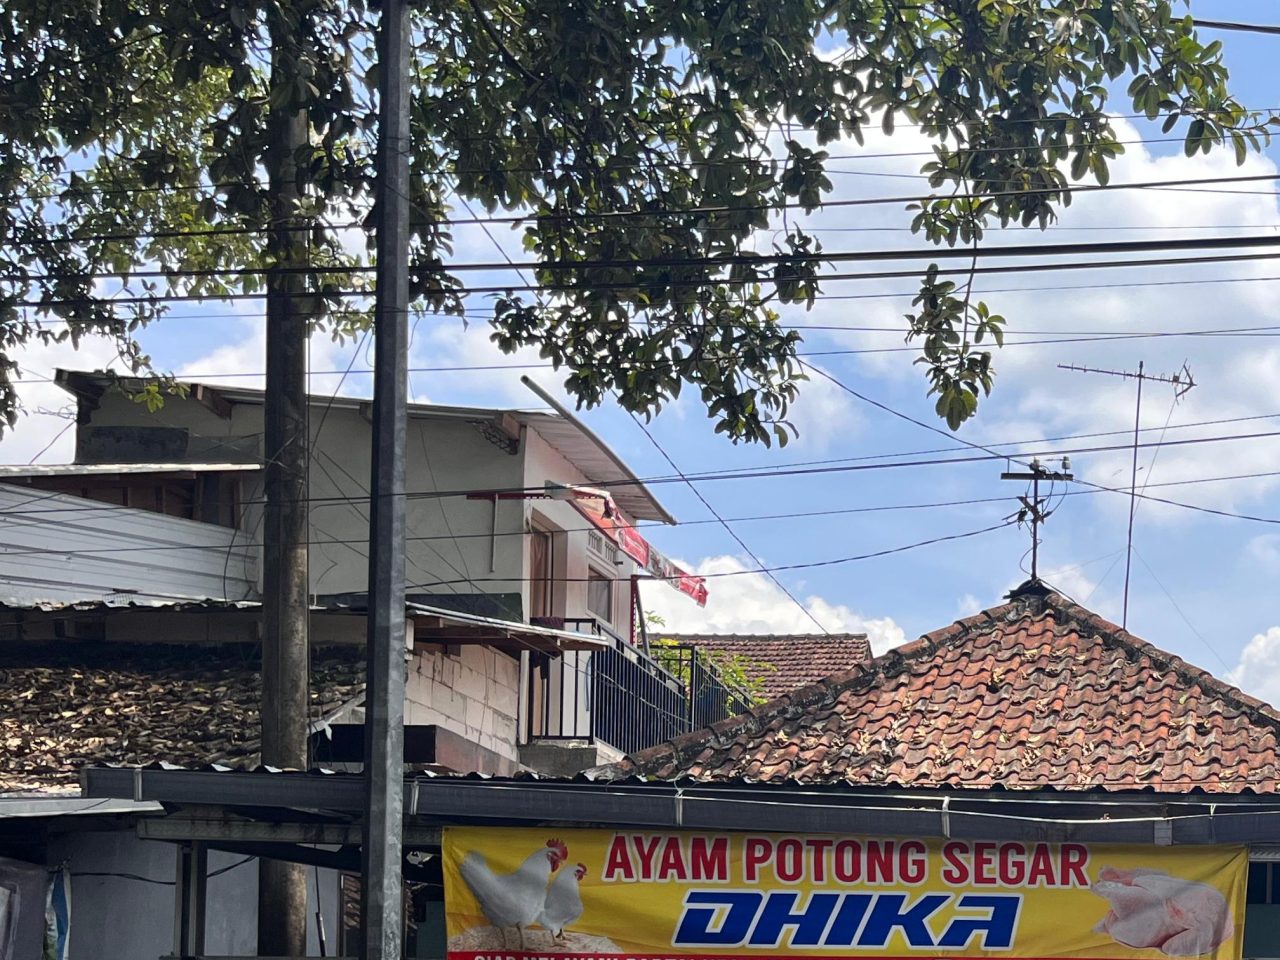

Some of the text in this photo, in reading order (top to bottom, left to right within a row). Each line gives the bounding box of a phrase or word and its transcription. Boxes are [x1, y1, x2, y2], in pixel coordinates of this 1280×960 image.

[604, 835, 1089, 886] AYAM POTONG SEGAR
[674, 890, 1020, 948] DHIKA
